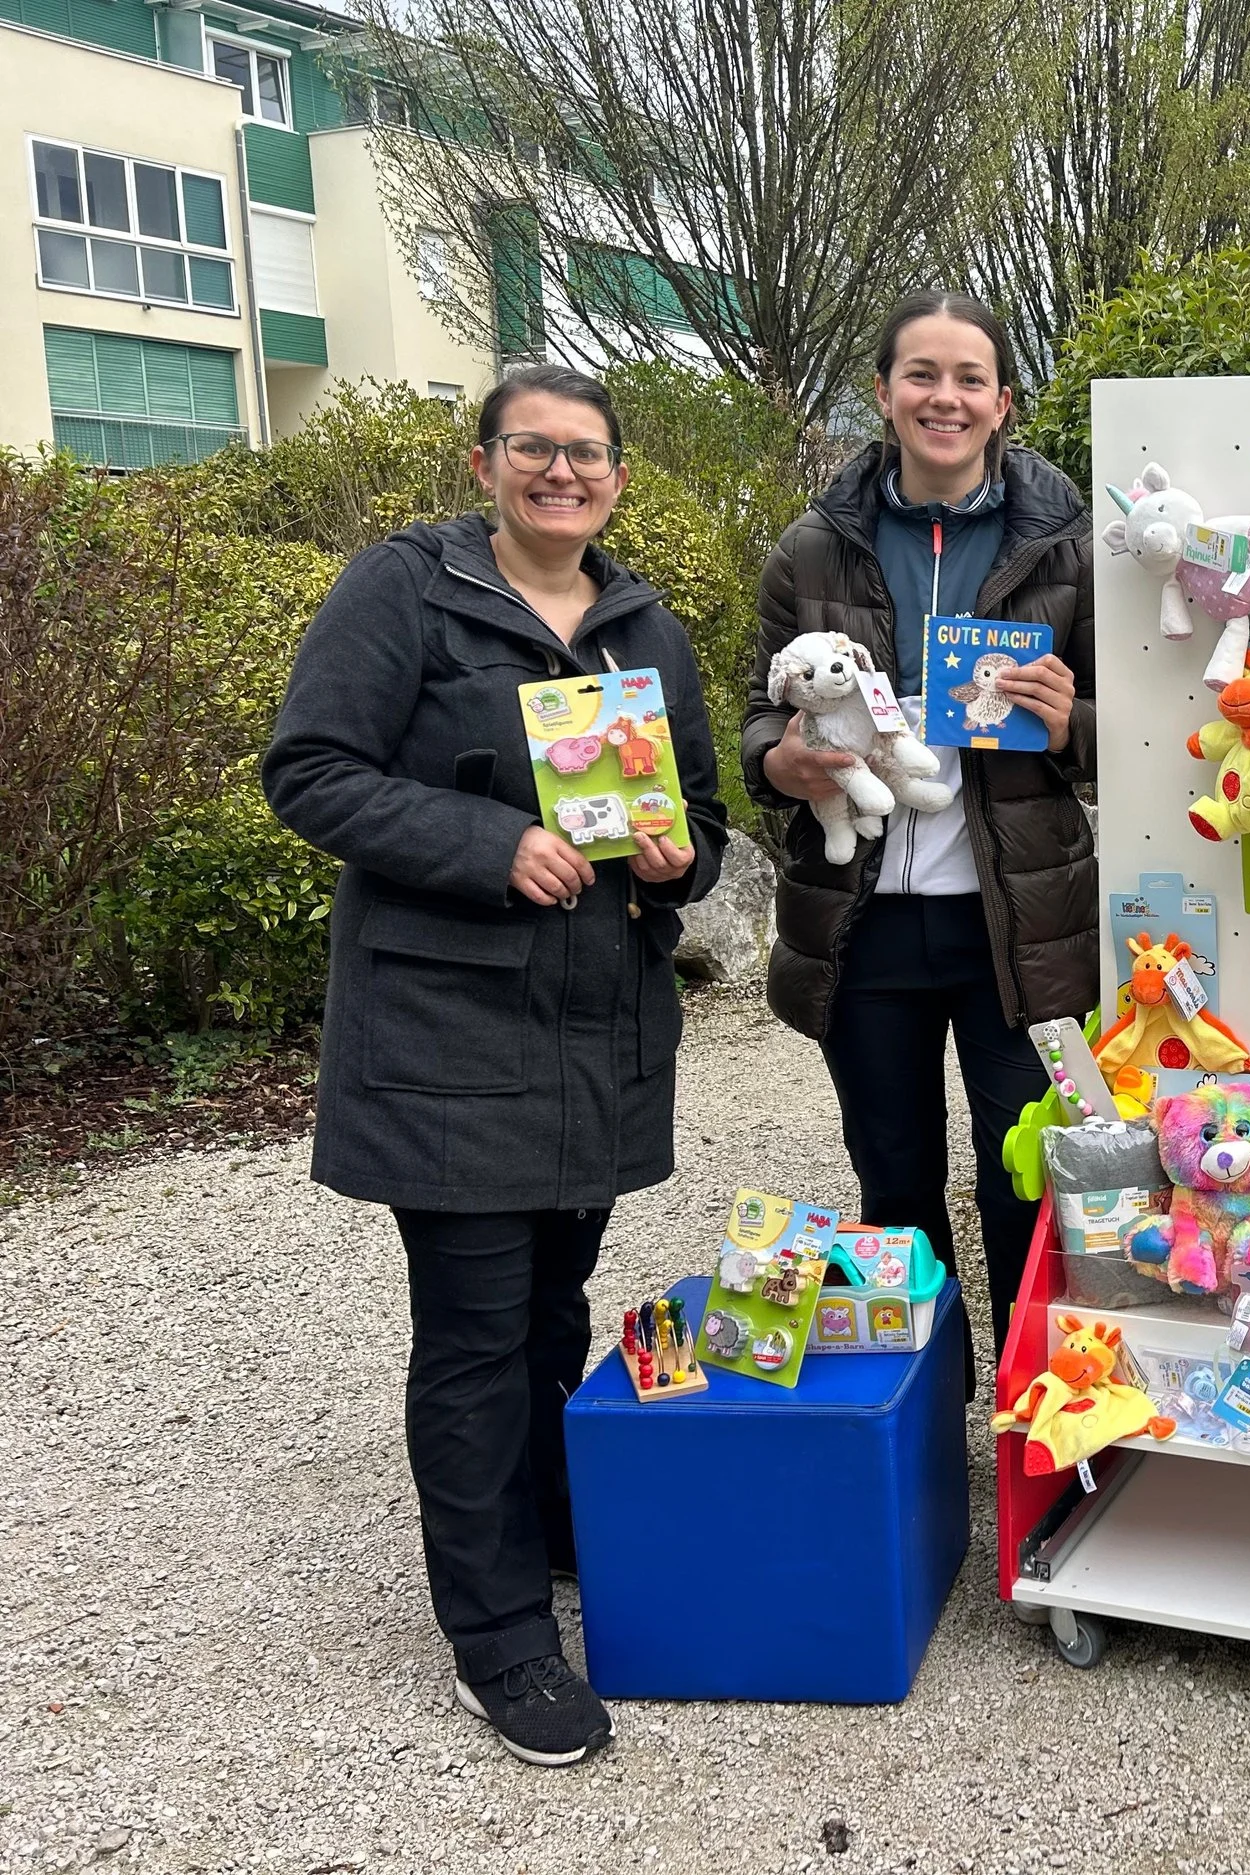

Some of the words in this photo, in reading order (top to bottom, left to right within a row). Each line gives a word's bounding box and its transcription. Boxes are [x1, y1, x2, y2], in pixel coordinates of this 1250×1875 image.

[937, 625, 981, 645] GUTE
[986, 628, 1042, 649] NACHT
[620, 675, 654, 690] HABA
[807, 1212, 832, 1228] HABA
[886, 1237, 910, 1245] 12m+
